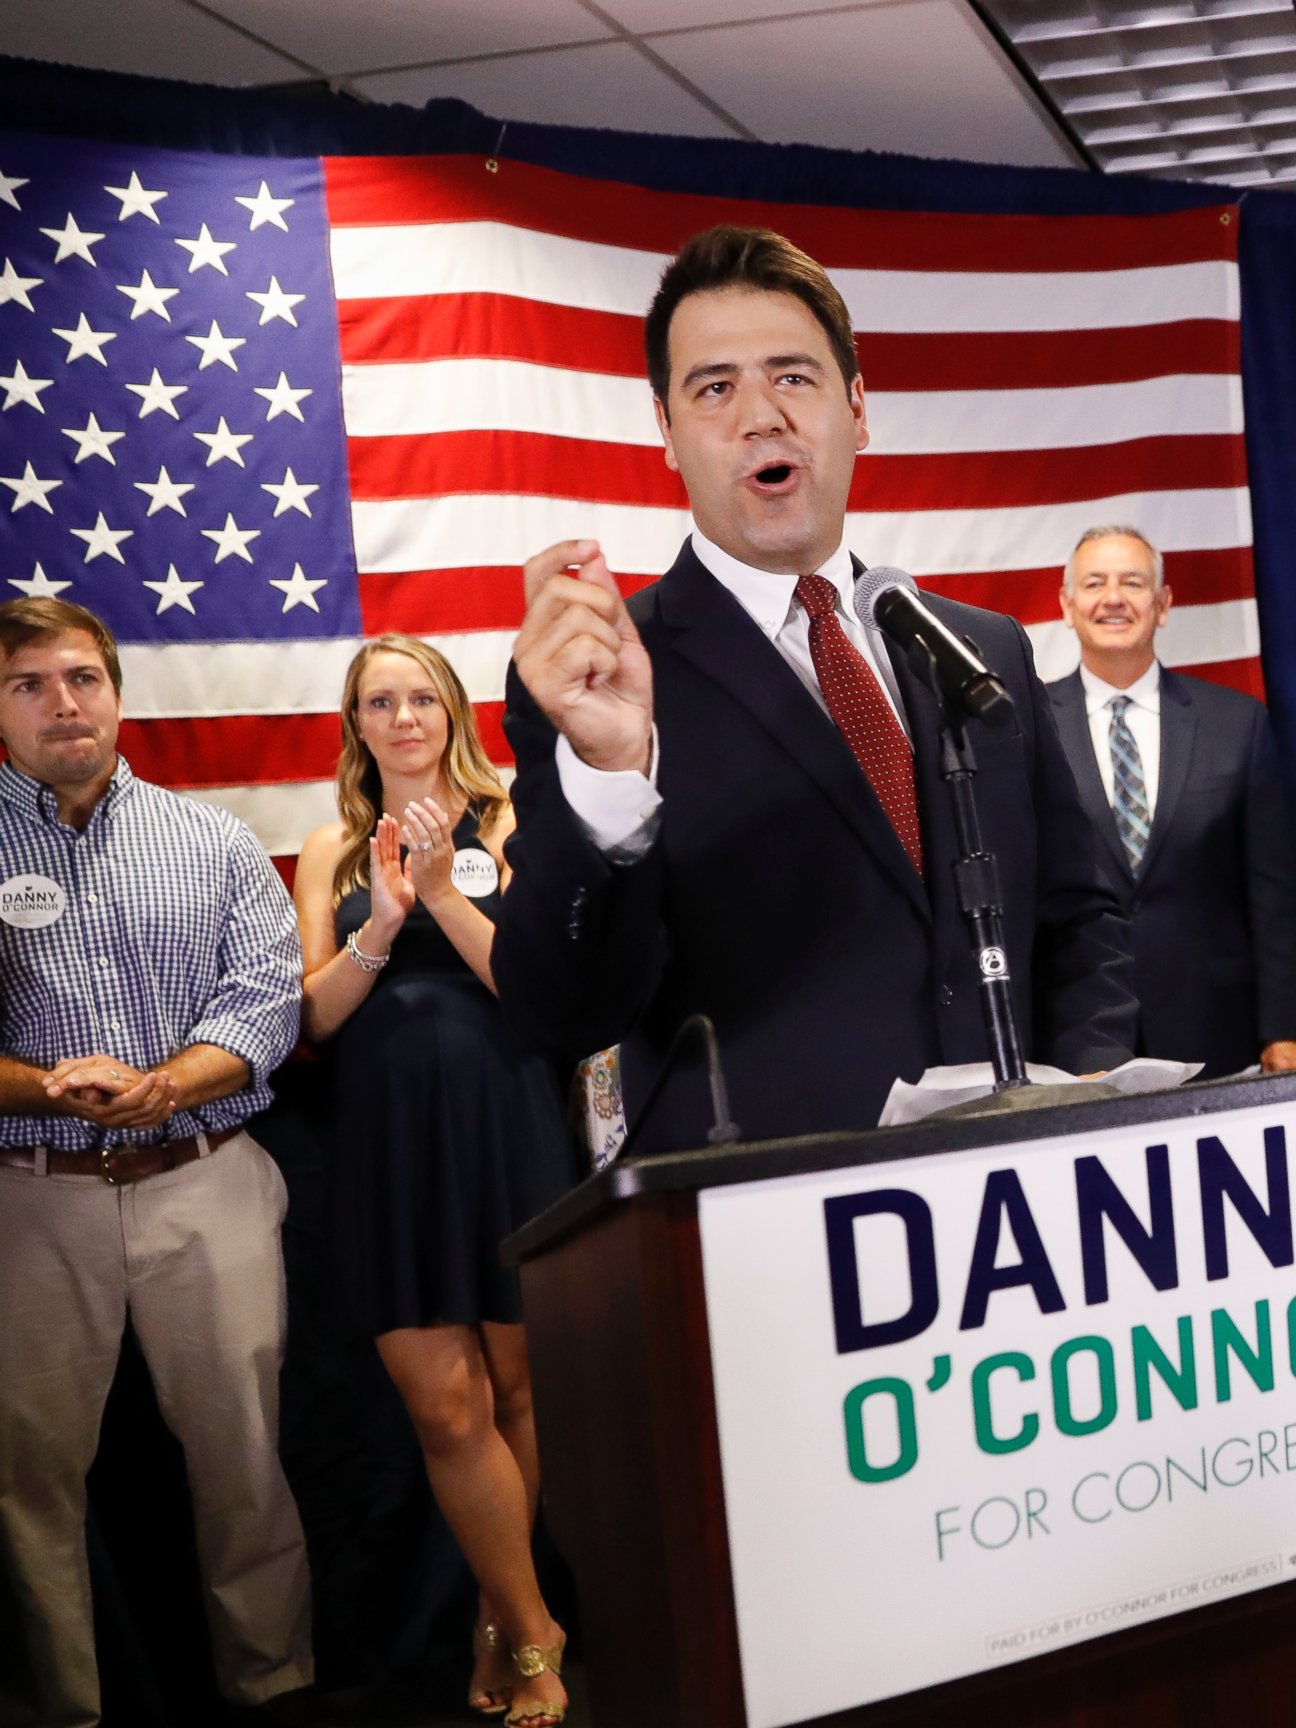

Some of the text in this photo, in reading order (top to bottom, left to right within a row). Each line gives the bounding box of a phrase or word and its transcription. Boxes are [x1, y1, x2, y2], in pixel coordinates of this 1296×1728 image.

[2, 891, 57, 904] DANNY
[2, 903, 59, 912] O'CONNOR
[935, 1488, 1050, 1561] FOR
[990, 1560, 1277, 1651] PAID FOR BY O'CONNOR FOR CONGRESS
